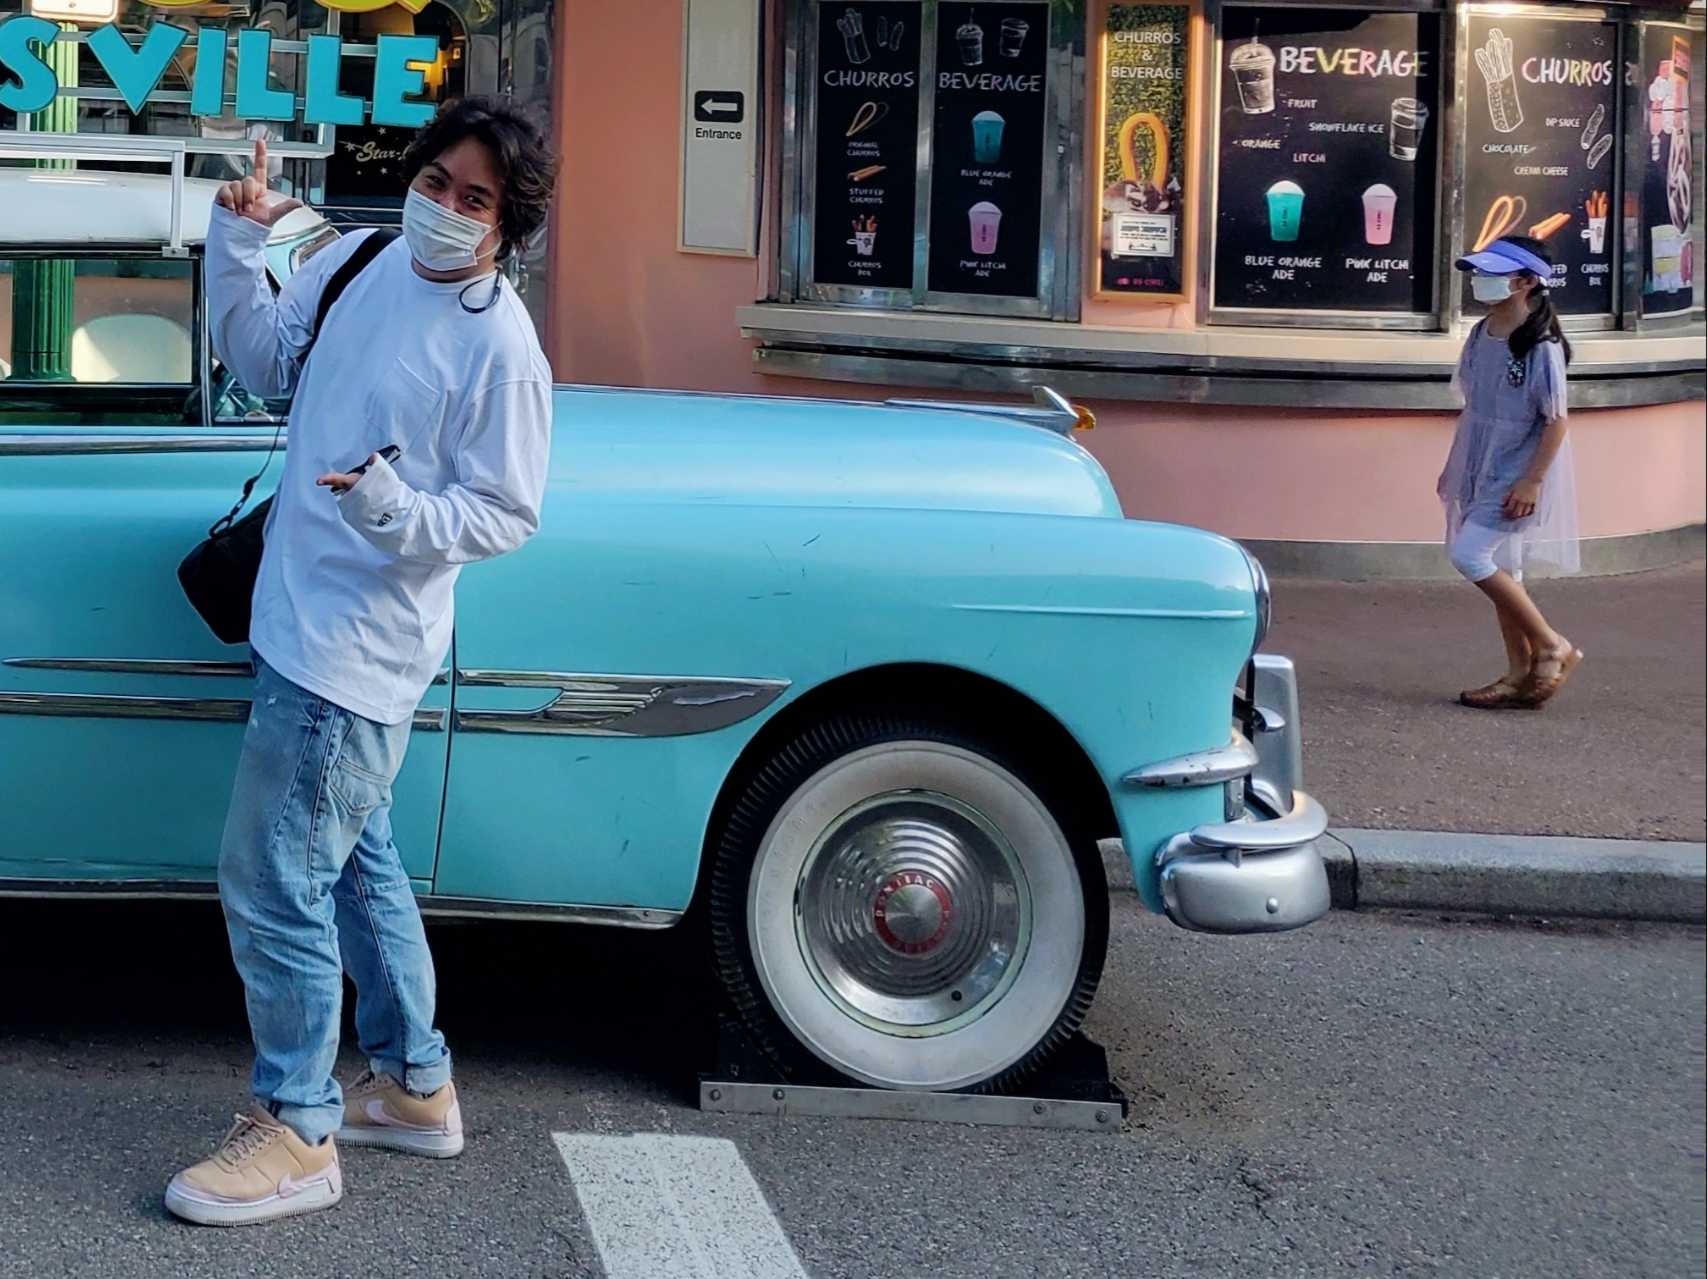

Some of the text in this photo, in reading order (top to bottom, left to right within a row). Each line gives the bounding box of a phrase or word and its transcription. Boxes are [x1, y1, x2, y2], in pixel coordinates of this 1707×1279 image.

[1115, 31, 1182, 45] CHURROS
[1141, 49, 1153, 61] &
[1279, 46, 1431, 78] BEVERAGE
[1111, 66, 1183, 80] BEVERAGE
[1521, 56, 1612, 87] CHURROS
[823, 70, 916, 89] CHURROS
[939, 72, 1043, 93] BEVERAGE
[1288, 99, 1319, 109] FRUIT
[695, 127, 743, 140] Entrance
[1308, 122, 1365, 133] SNOWFLAKE
[1241, 139, 1282, 150] ORANGE
[1482, 143, 1529, 154] CHOCOLATE
[355, 141, 408, 163] Star-
[960, 169, 980, 177] BLUE
[1514, 166, 1569, 176] CREAM CHEESE
[848, 187, 885, 196] STUFFED
[1244, 255, 1323, 268] BLUE ORANGE
[1272, 269, 1296, 280] ADE
[1366, 272, 1388, 283] ADE
